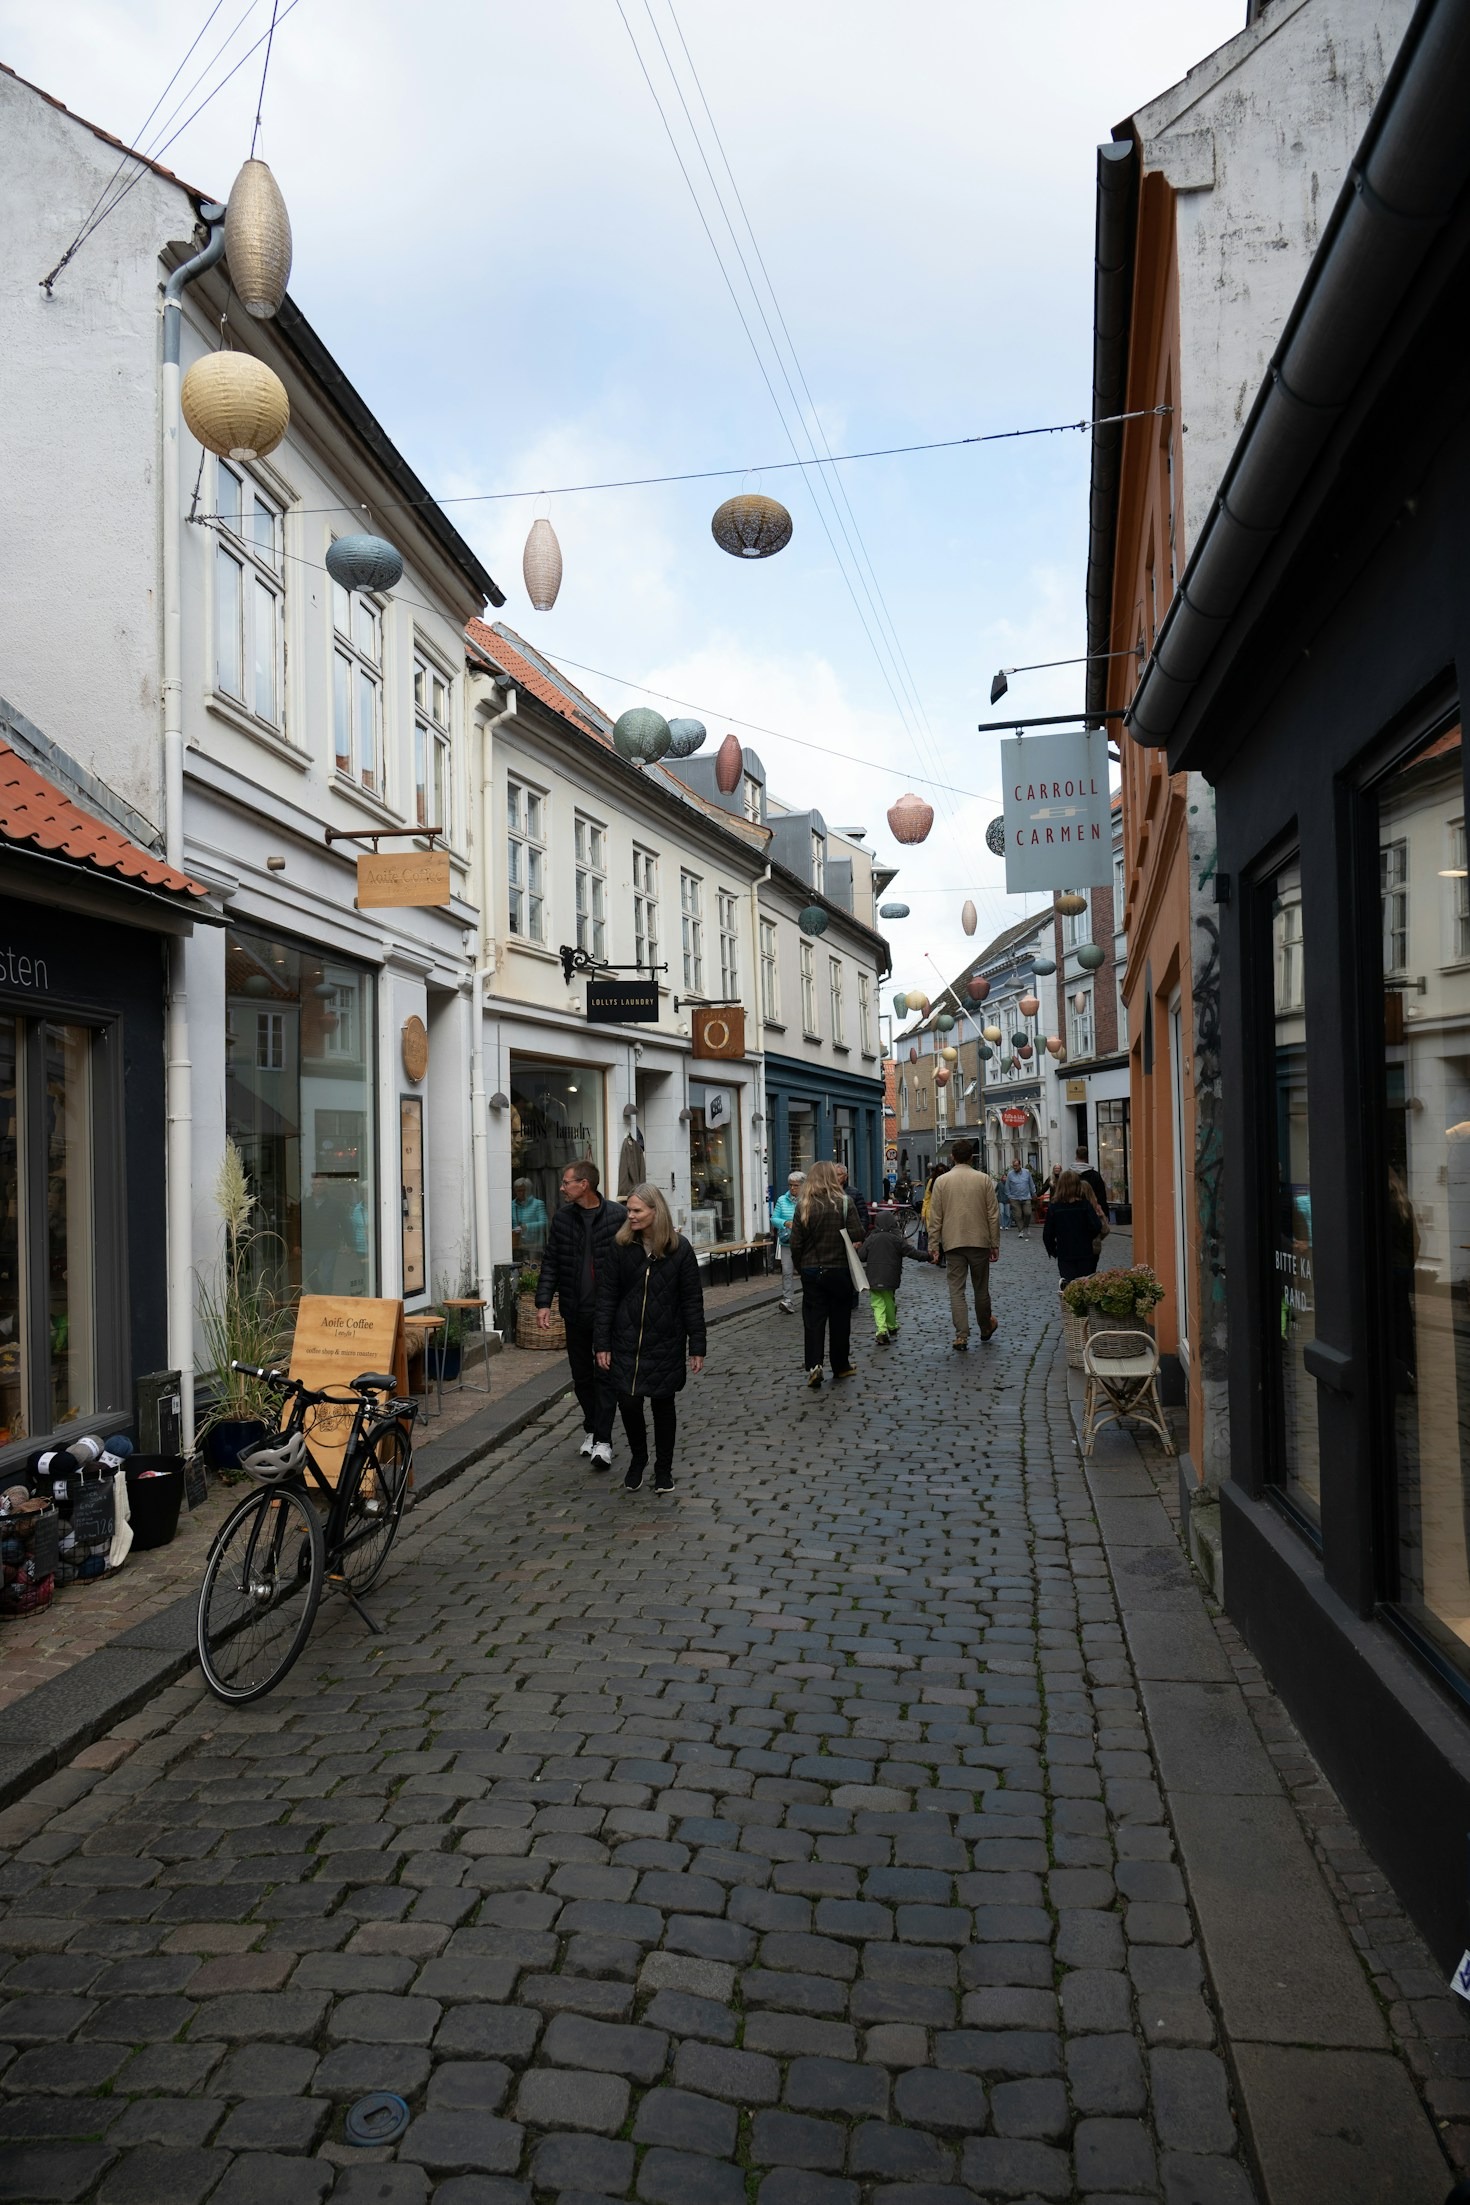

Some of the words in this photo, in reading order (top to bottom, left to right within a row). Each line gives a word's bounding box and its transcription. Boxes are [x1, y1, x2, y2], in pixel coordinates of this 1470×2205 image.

[1014, 779, 1098, 802] CARROLL
[1016, 823, 1101, 846] CARMEN
[366, 869, 399, 885] Aoife
[402, 867, 442, 884] Coffee
[591, 998, 618, 1006] LOLLYS
[621, 998, 654, 1006] LAUNDRY
[1275, 1250, 1297, 1275] BITTE
[1284, 1285, 1307, 1312] RAND
[321, 1317, 345, 1328] Aoife
[347, 1317, 374, 1330] Coffee
[305, 1347, 321, 1355] coffee
[322, 1348, 334, 1357] shop
[356, 1350, 378, 1359] roastery
